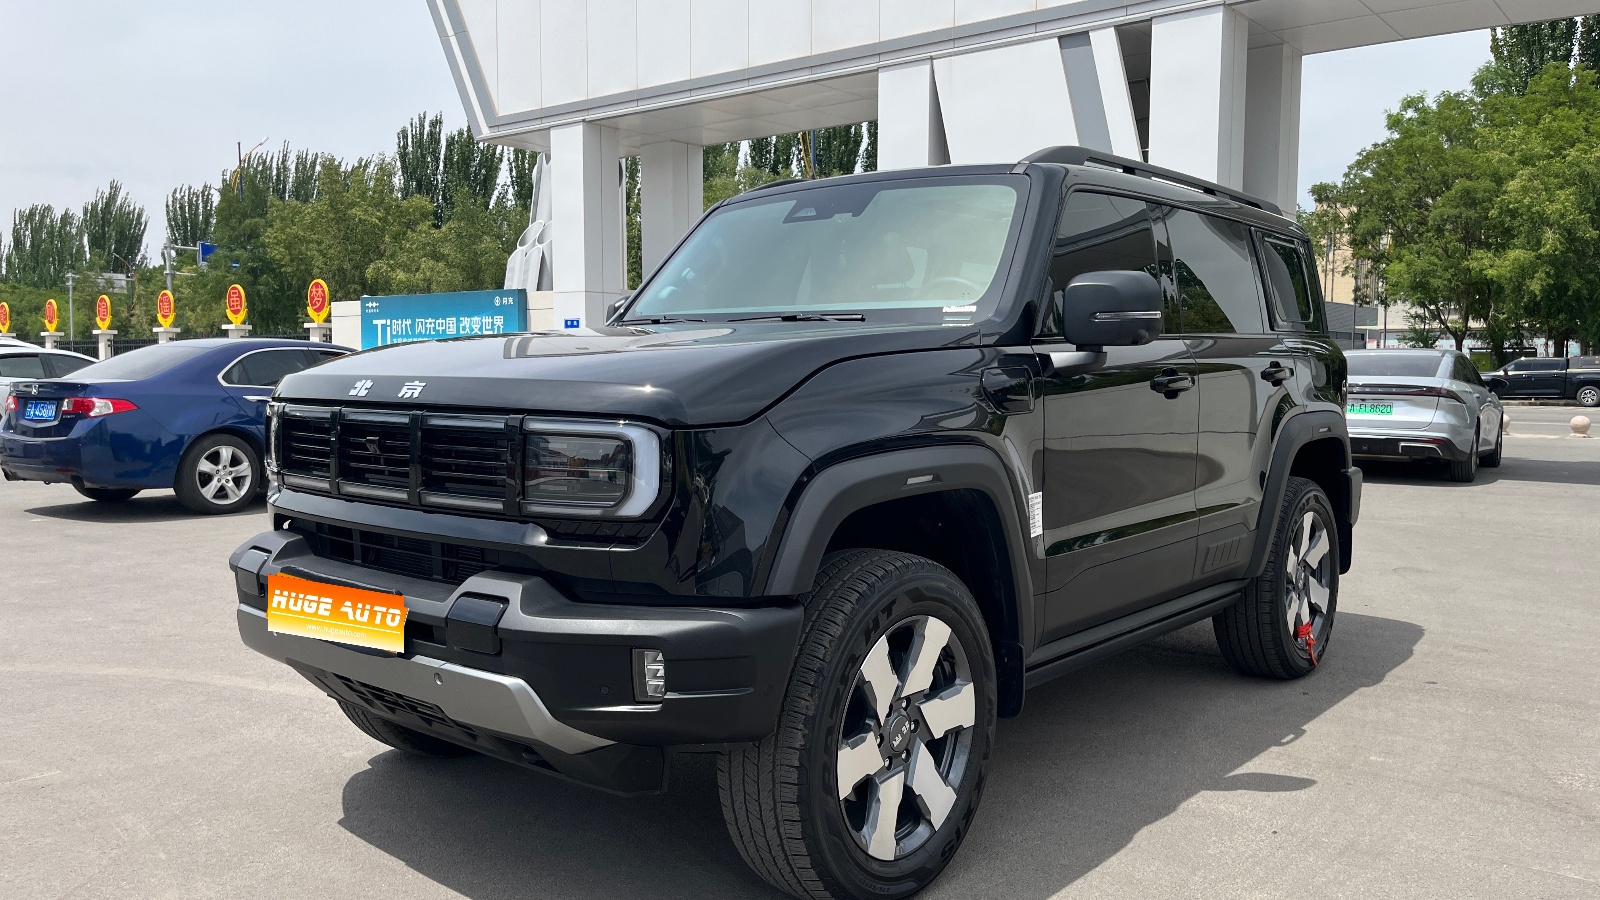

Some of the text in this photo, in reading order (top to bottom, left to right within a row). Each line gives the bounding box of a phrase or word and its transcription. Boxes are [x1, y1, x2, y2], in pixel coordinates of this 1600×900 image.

[159, 295, 172, 316] 遥
[229, 289, 242, 311] 虽
[310, 285, 324, 309] 梦
[415, 317, 457, 335] 闪充中国
[459, 315, 504, 335] 改变世界
[348, 379, 427, 399] 北京
[863, 598, 896, 646] HT
